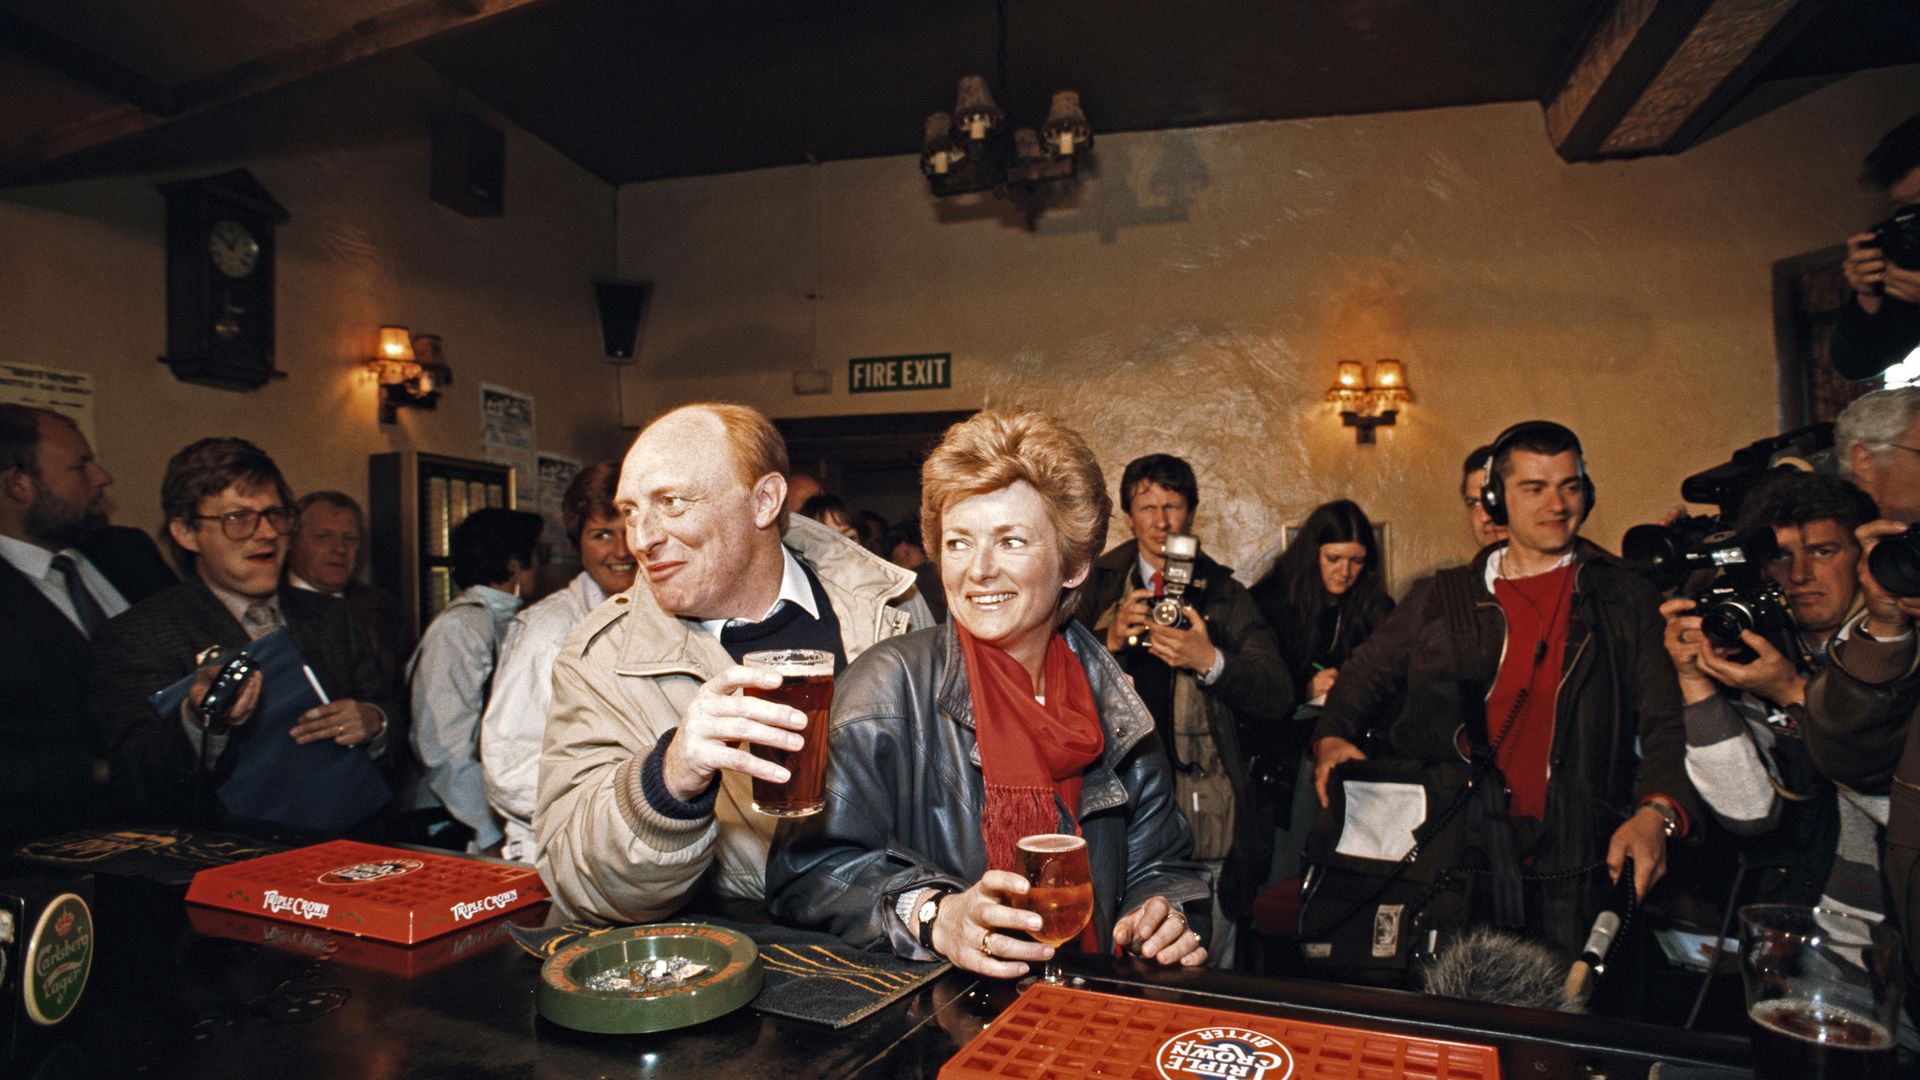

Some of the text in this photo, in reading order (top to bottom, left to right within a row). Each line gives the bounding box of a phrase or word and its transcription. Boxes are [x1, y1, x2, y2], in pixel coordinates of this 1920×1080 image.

[853, 358, 946, 388] FIRE EXIT
[262, 889, 329, 919] TRIPLE CROWN
[450, 889, 518, 921] TRIPLE CROWN
[36, 927, 88, 976] Carlsberg
[43, 966, 81, 999] Lager
[1197, 1029, 1274, 1049] BITTER
[1170, 1040, 1282, 1070] CROWN
